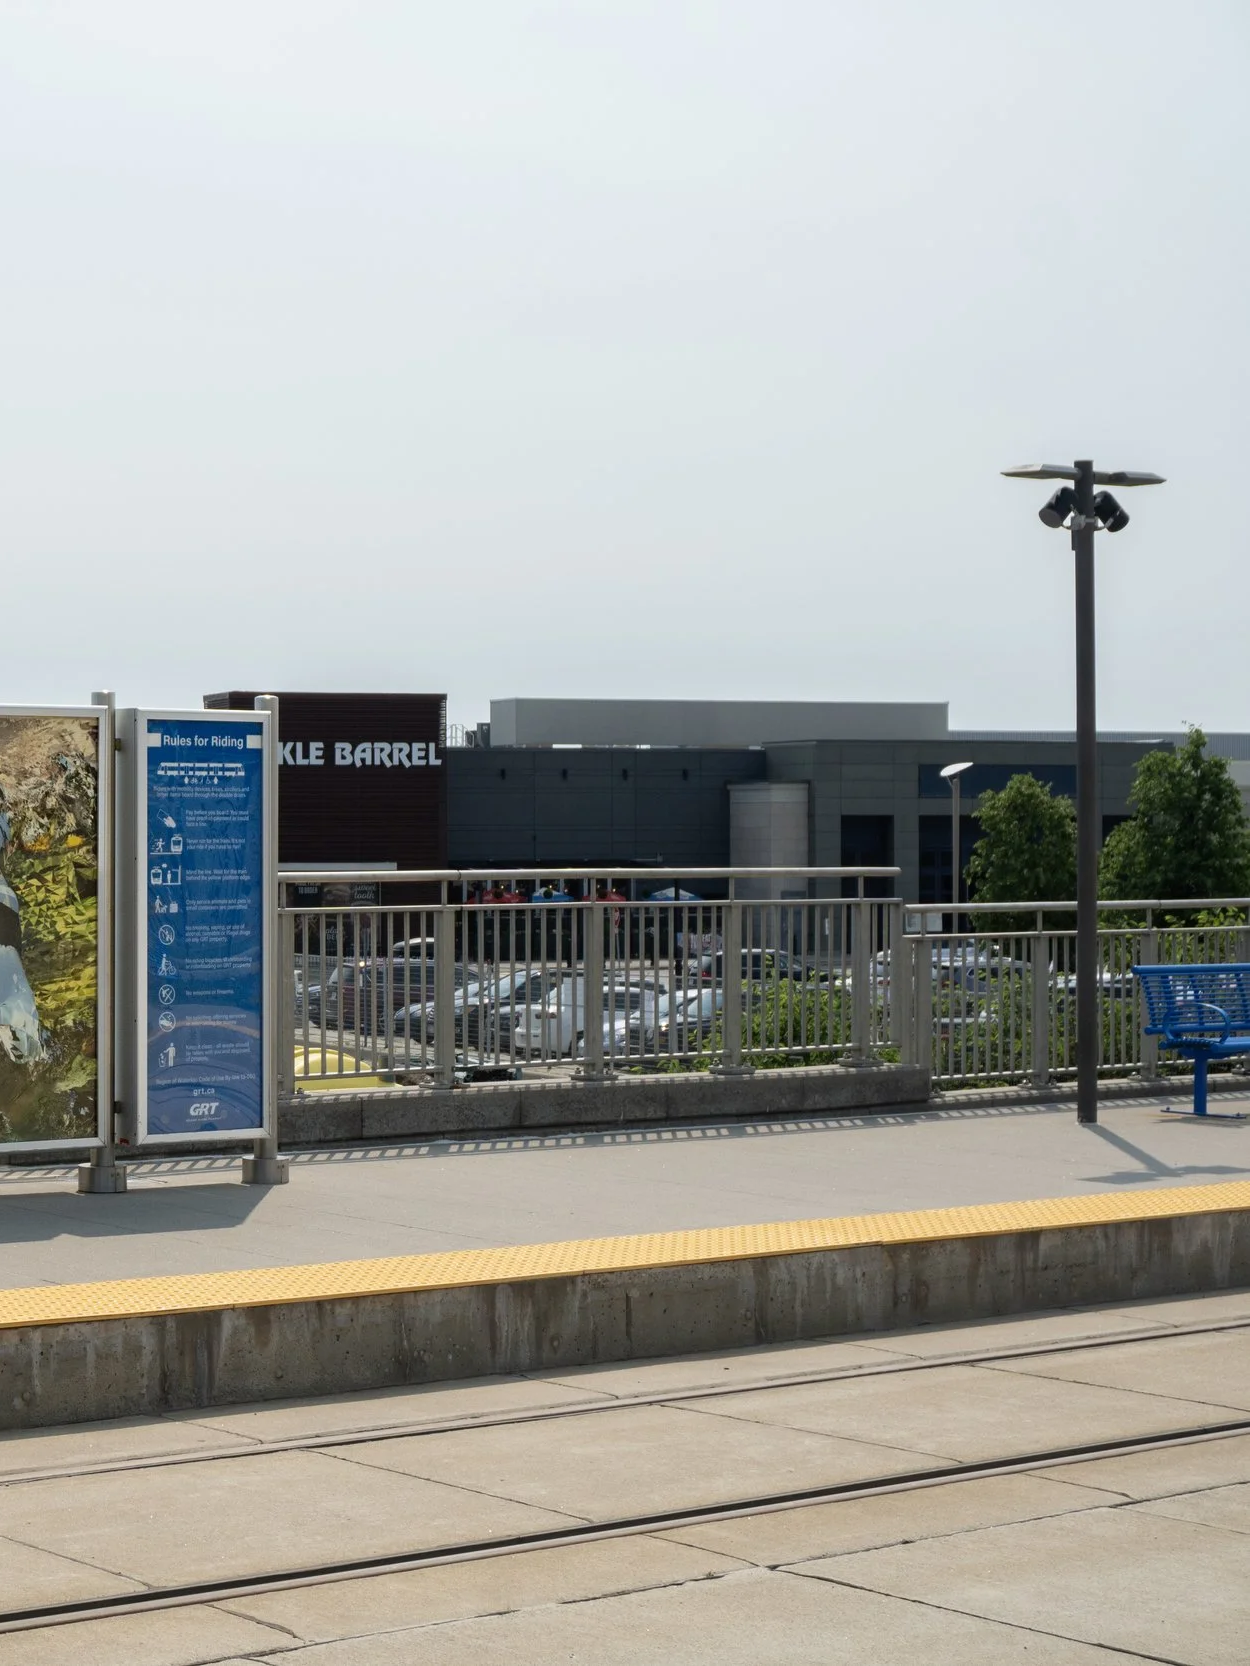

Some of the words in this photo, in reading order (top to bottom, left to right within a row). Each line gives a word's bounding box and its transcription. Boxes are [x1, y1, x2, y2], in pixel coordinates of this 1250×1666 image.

[163, 735, 191, 746] Rules
[194, 735, 208, 746] for
[211, 736, 244, 749] Riding
[334, 742, 442, 768] BARREL
[193, 1088, 215, 1096] grt.ca
[190, 1102, 219, 1116] GRT
